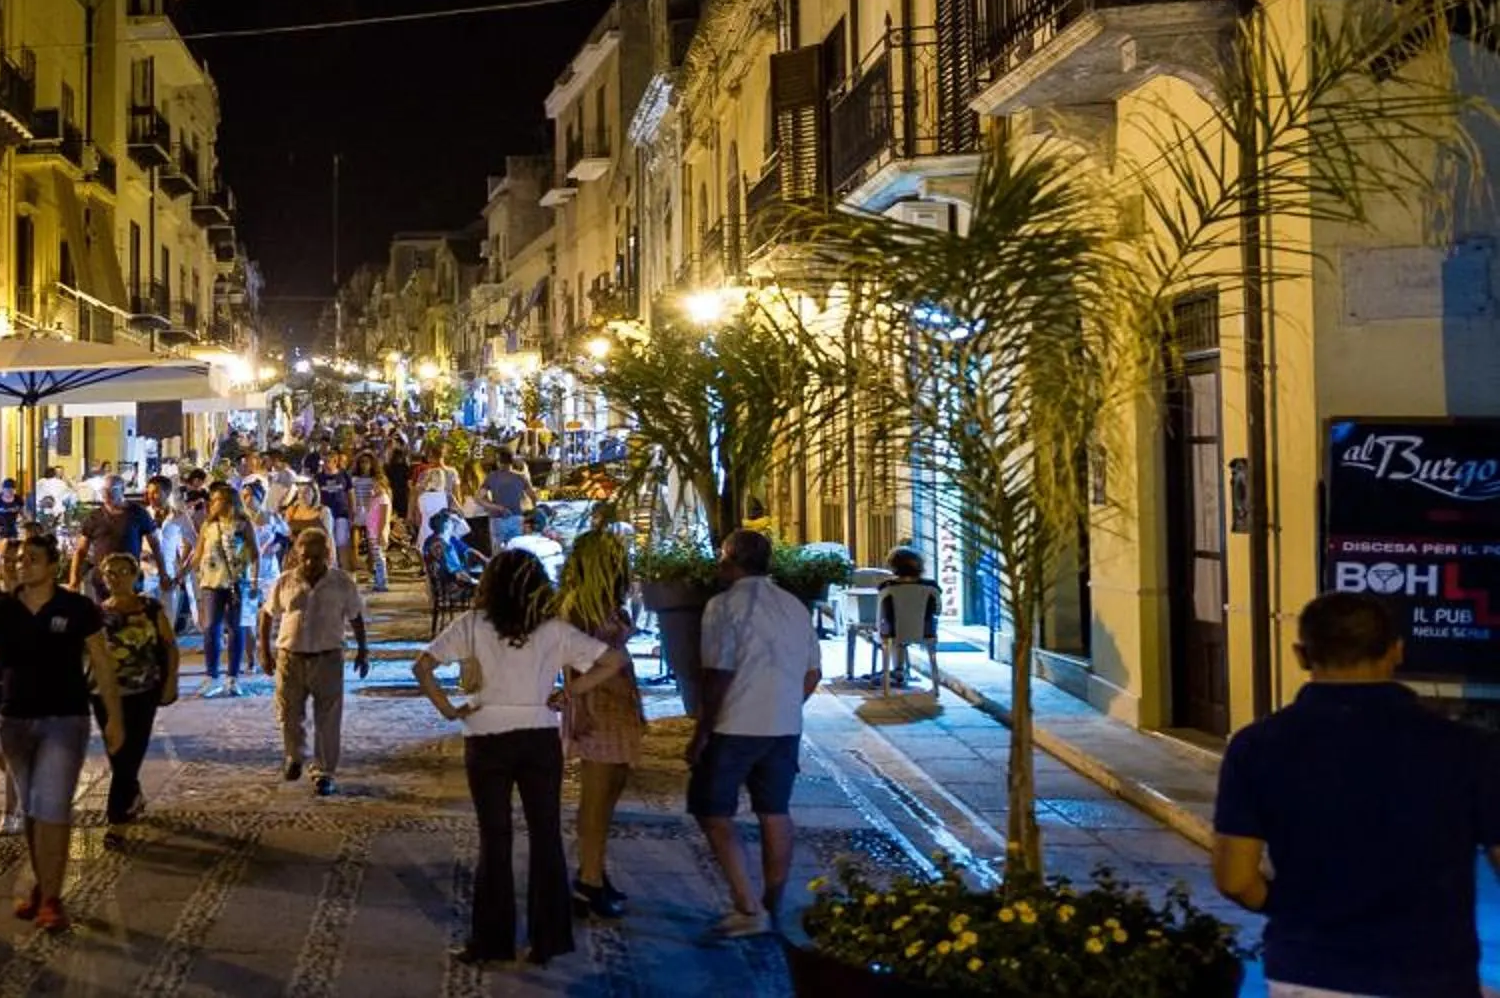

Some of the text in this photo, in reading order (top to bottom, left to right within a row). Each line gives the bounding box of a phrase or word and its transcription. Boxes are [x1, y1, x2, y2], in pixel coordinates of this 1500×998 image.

[1342, 433, 1497, 492] al Burgo
[1342, 541, 1417, 554] DISCESA
[1423, 542, 1457, 555] PER
[1461, 544, 1478, 555] IL
[1336, 561, 1438, 596] BOH
[1413, 606, 1473, 624] IL PUB
